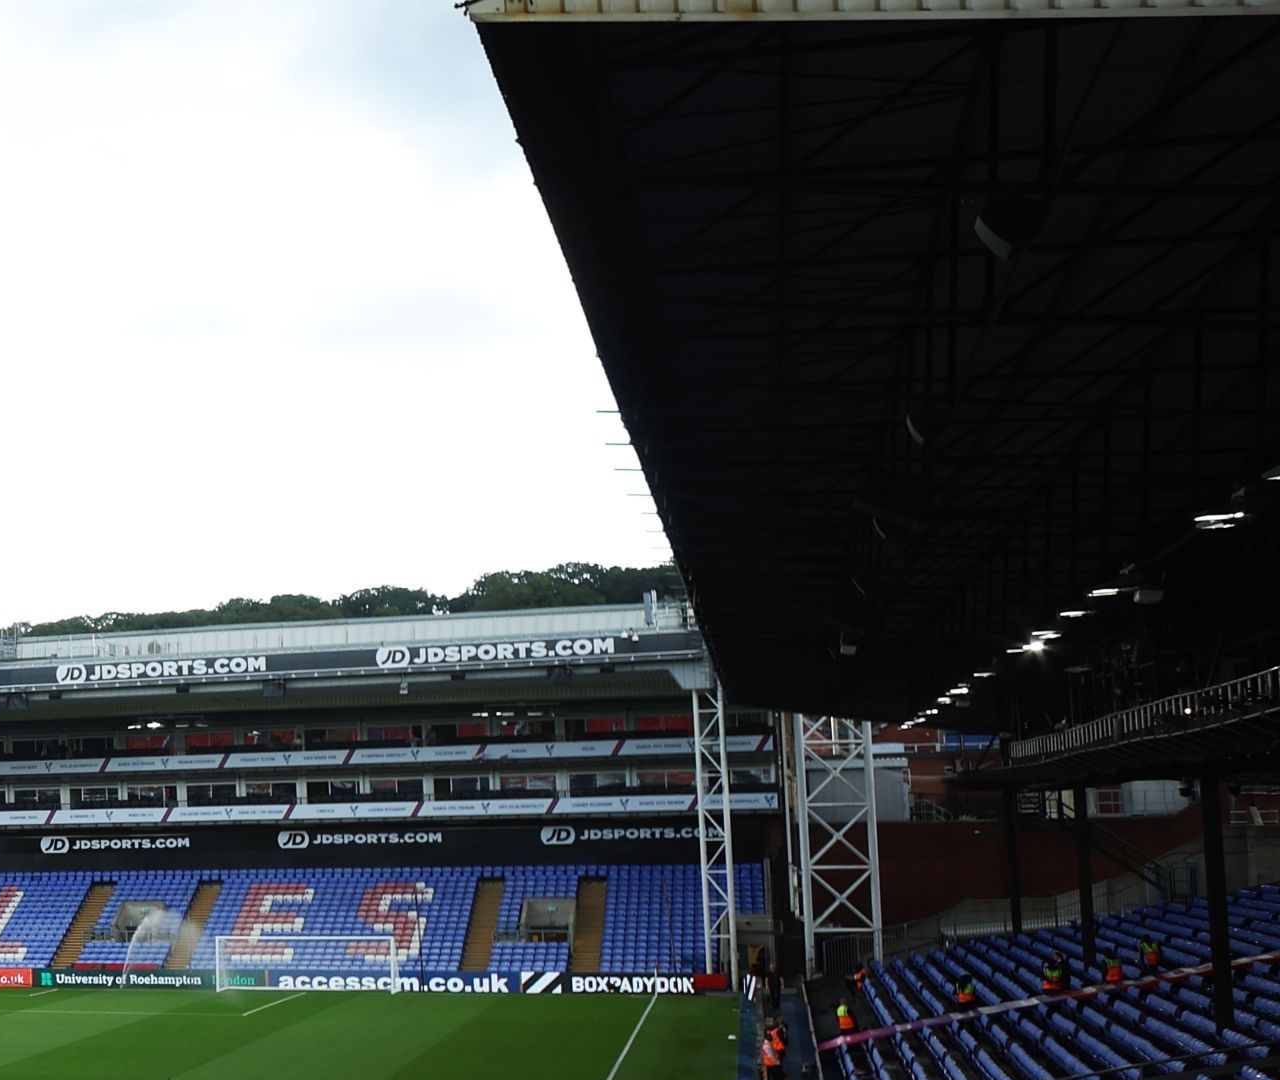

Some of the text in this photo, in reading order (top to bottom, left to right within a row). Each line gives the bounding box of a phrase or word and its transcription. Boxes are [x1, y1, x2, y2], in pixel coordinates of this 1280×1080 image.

[413, 637, 615, 664] JDSPORTS.COM
[88, 656, 267, 681] JDSPORTS.COM
[72, 837, 190, 850] JDSPORTS.COM
[313, 832, 442, 846] JDSPORTS.COM
[56, 974, 115, 988] University
[116, 973, 126, 984] of
[129, 974, 202, 987] Roehampton
